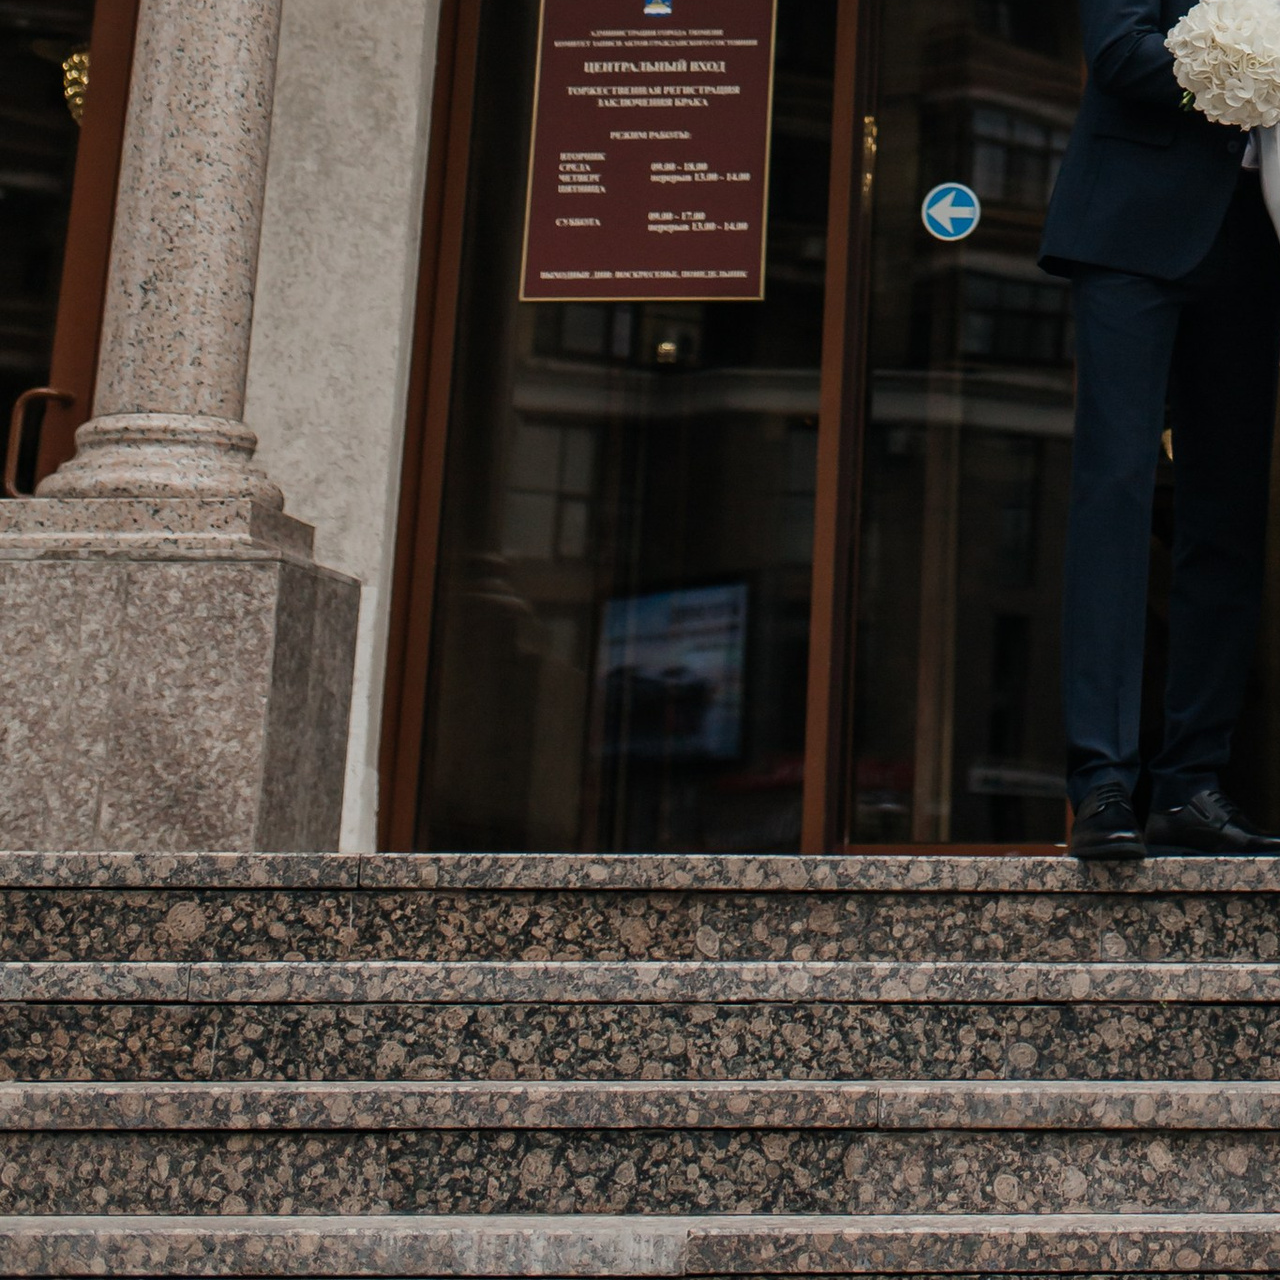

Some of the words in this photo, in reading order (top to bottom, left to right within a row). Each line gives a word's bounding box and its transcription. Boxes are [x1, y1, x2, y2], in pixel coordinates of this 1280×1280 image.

[584, 59, 687, 73] ЦЕНТРАЛЬНЫЙ
[690, 61, 726, 73] ВХОД
[566, 86, 662, 95] ТОРЖЕСТВЕННАЯ
[663, 85, 740, 96] РЕГИСТРАЦИЯ
[598, 98, 673, 107] ЗАКЛЮЧЕНИЯ
[674, 98, 708, 107] БРАКА
[610, 131, 647, 139] РЕЖИМ
[560, 152, 606, 161] ВТОРНИК
[558, 163, 591, 172] СРЕДА
[558, 174, 602, 183] ЧЕТВЕРГ
[650, 174, 692, 184] перерыв
[557, 185, 606, 193] ПЯТНИЦА
[555, 218, 601, 227] СУББОТА
[648, 223, 690, 233] перерыв
